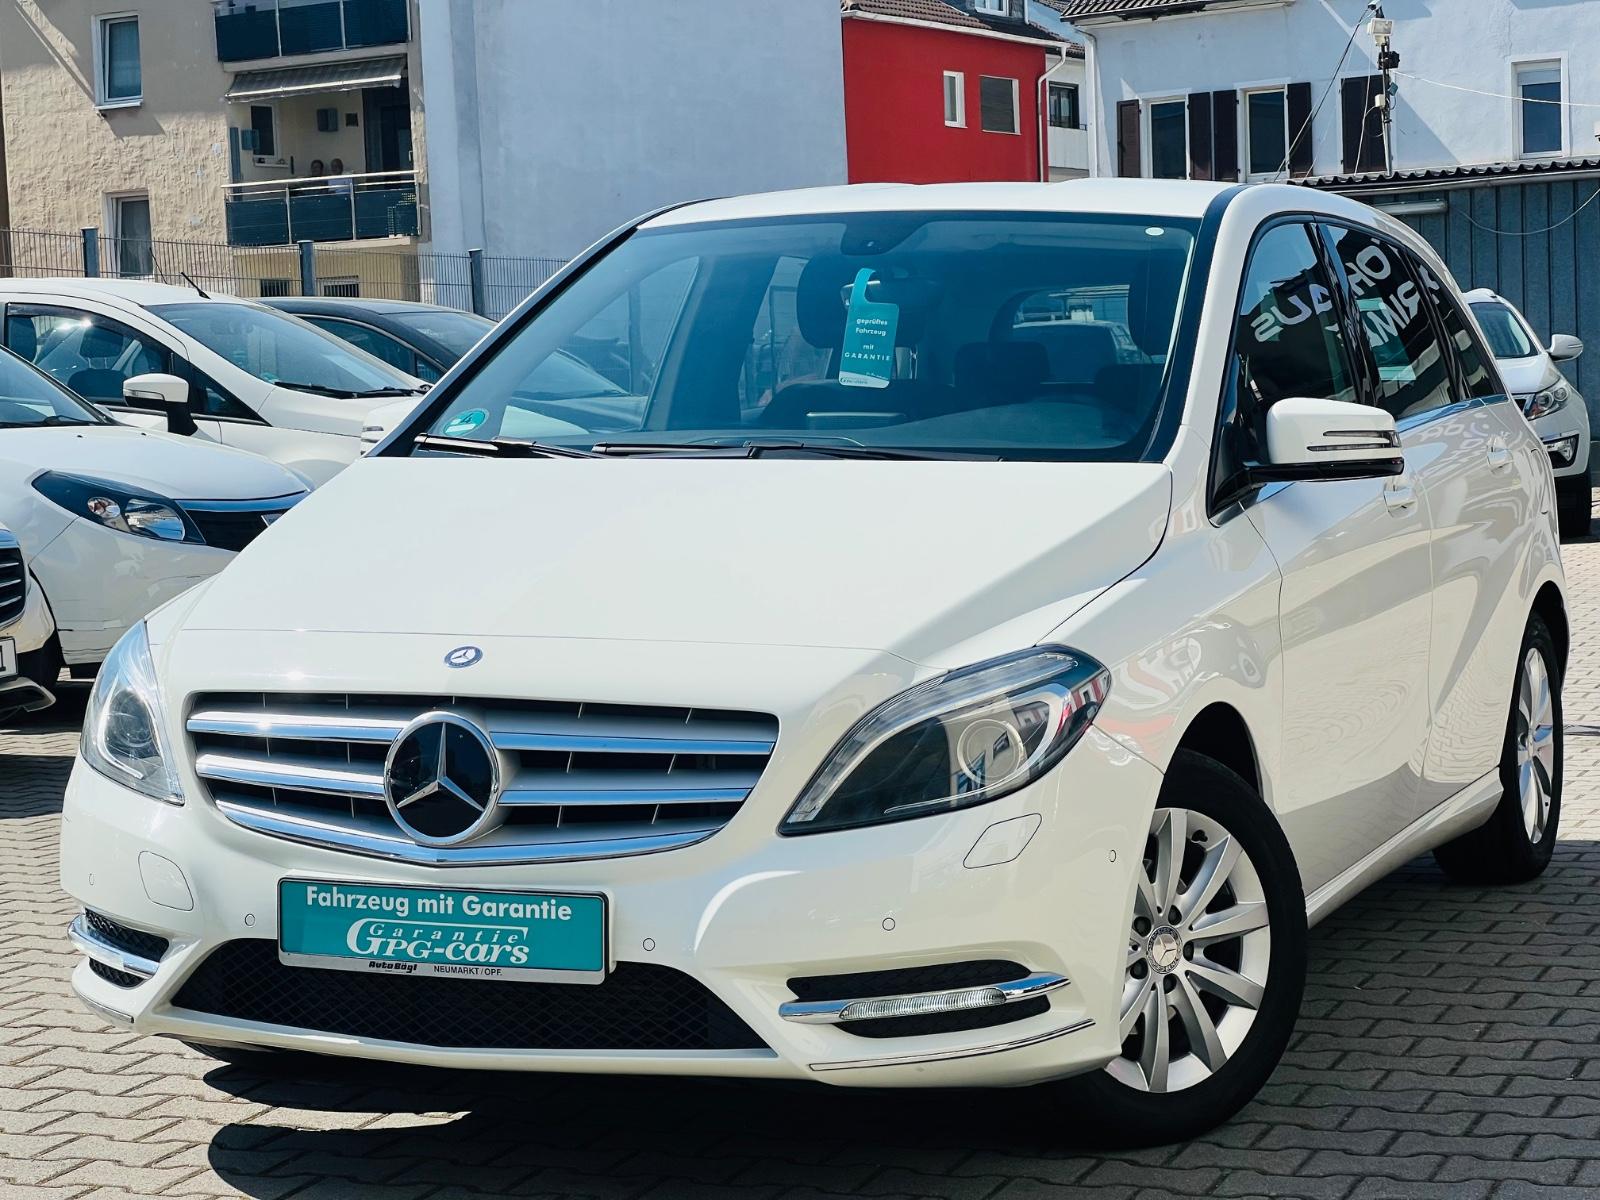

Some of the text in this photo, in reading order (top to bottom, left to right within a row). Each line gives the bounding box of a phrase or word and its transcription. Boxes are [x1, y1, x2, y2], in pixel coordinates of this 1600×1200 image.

[855, 327, 887, 336] Fahrzeug
[862, 343, 874, 351] mit
[844, 352, 891, 361] GARANTIE
[306, 885, 573, 921] Fahrzeug mit Garantie
[369, 922, 519, 944] Garantie
[346, 918, 530, 964] GPG-cars
